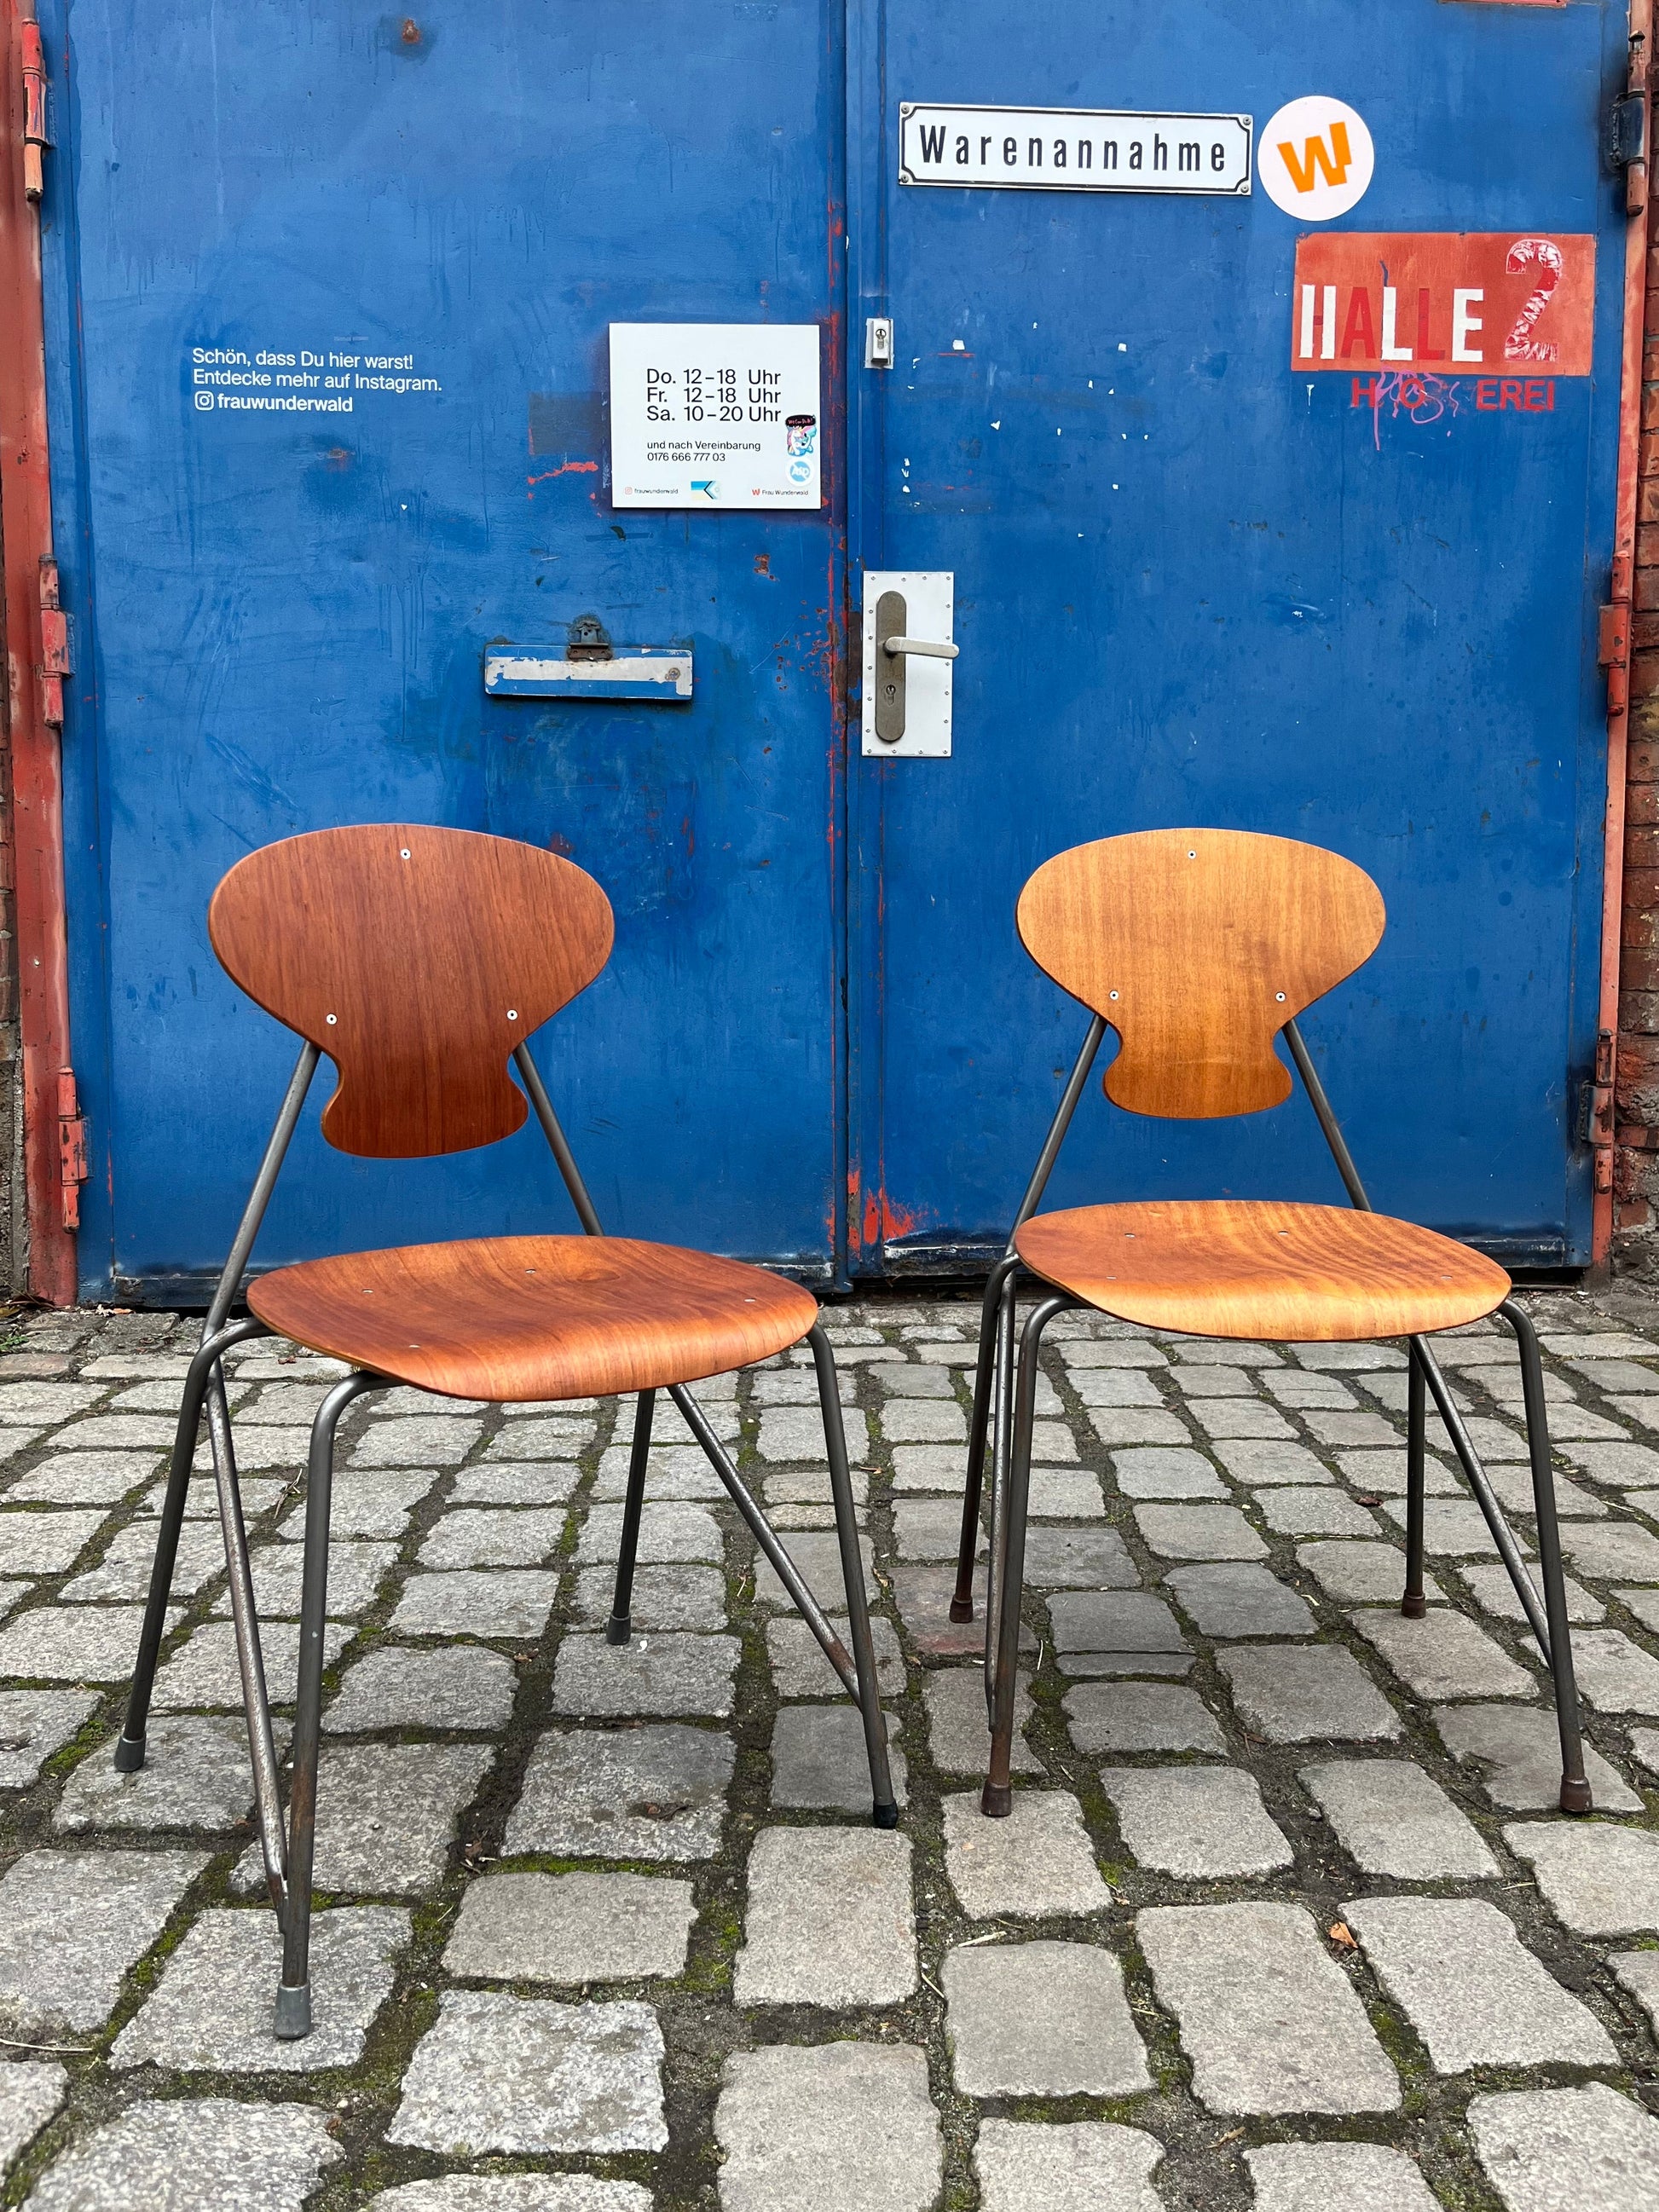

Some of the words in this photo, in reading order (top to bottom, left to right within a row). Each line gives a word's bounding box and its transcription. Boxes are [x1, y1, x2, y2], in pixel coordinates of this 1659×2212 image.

[919, 124, 1225, 171] Warenannahme
[1299, 284, 1483, 362] HALLE
[1505, 239, 1562, 362] 2
[192, 347, 251, 367] Schön,
[255, 349, 297, 367] dass
[300, 350, 325, 367] Du
[329, 351, 361, 368] hier
[365, 354, 413, 370] warst!
[194, 368, 272, 386] Entdecke
[276, 372, 321, 388] mehr
[324, 373, 351, 389] auf
[355, 373, 442, 394] Instagram.
[646, 368, 677, 384] Do.
[748, 368, 781, 385] Uhr
[217, 393, 353, 413] frauwunderwald
[647, 386, 668, 403] Fr.
[749, 387, 782, 403] Uhr
[646, 405, 676, 422] Sa.
[749, 406, 782, 422] Uhr
[647, 441, 666, 450] und
[668, 441, 693, 450] nach
[694, 441, 761, 453] Vereinbarung
[647, 452, 669, 462] 0176
[671, 452, 691, 462] 666
[693, 453, 710, 462] 777
[712, 453, 725, 462] 03
